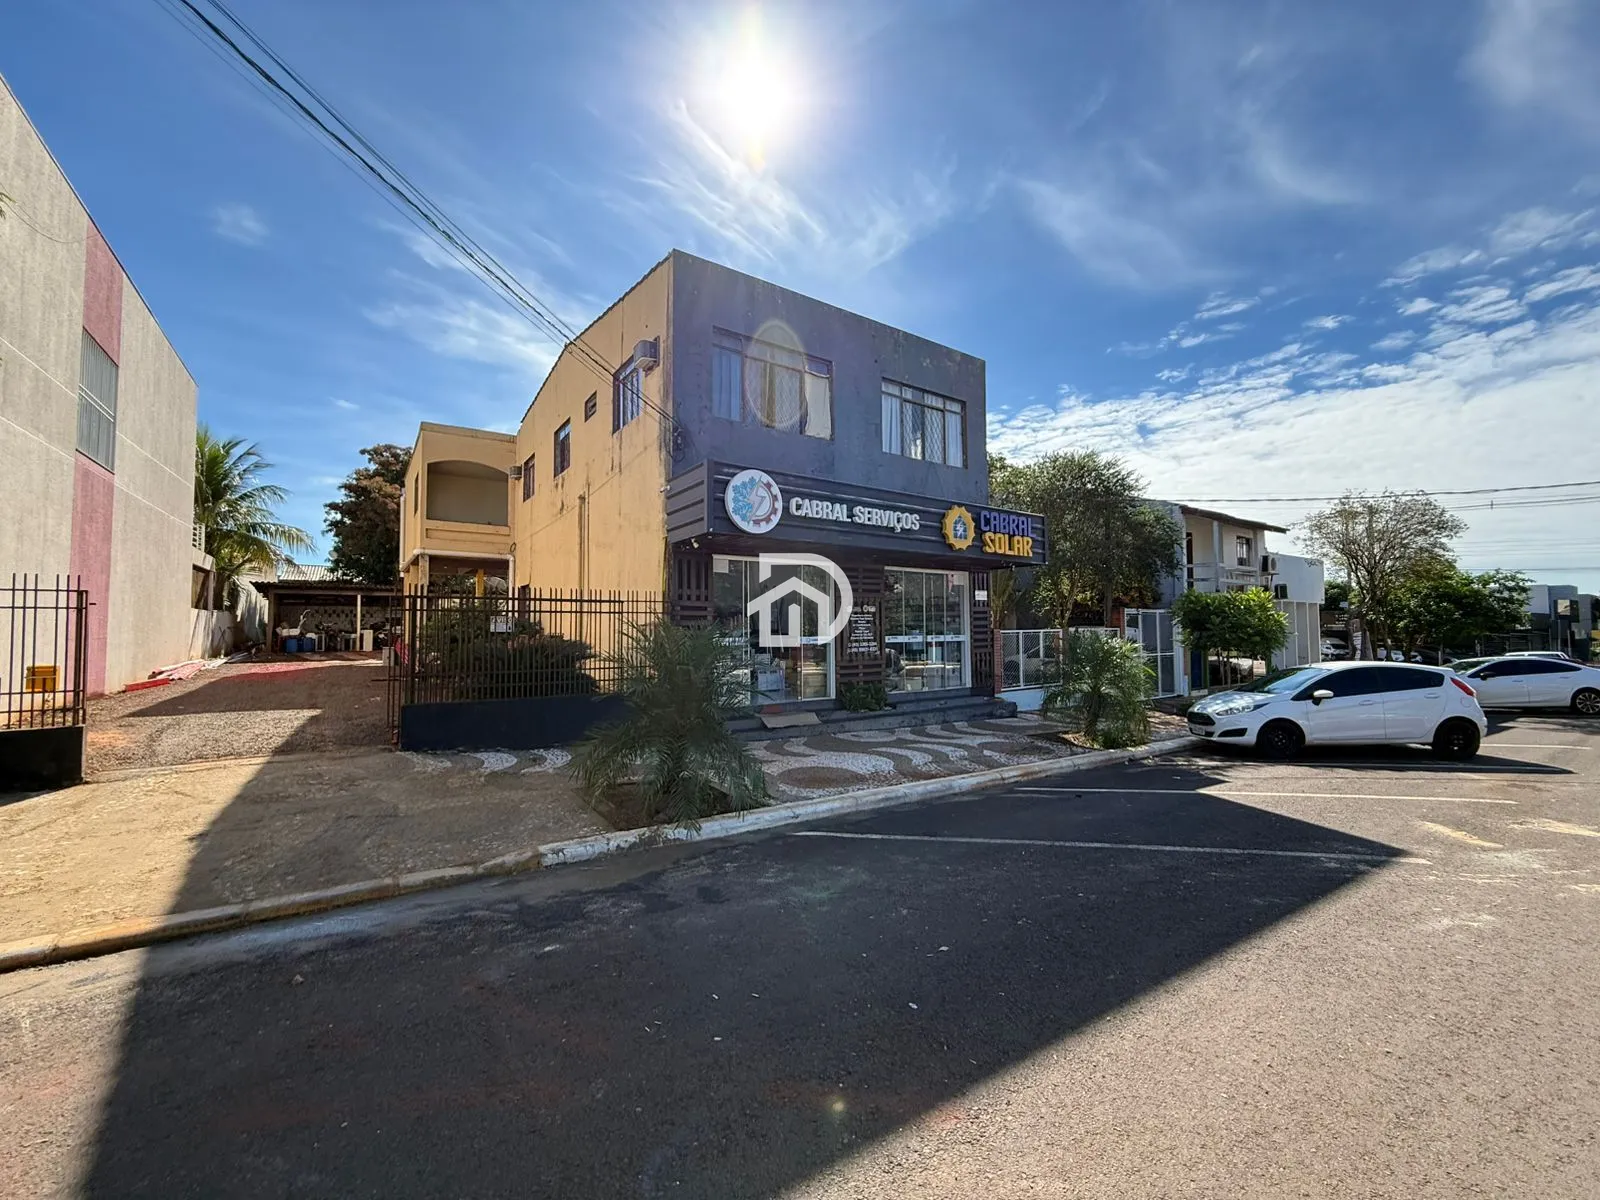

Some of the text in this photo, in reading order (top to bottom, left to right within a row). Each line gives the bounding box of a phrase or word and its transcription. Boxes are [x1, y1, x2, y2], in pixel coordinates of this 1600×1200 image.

[789, 496, 920, 533] CABRAL SERVIÇOS
[980, 510, 1037, 538] CABRAL
[982, 531, 1033, 557] SOLAR
